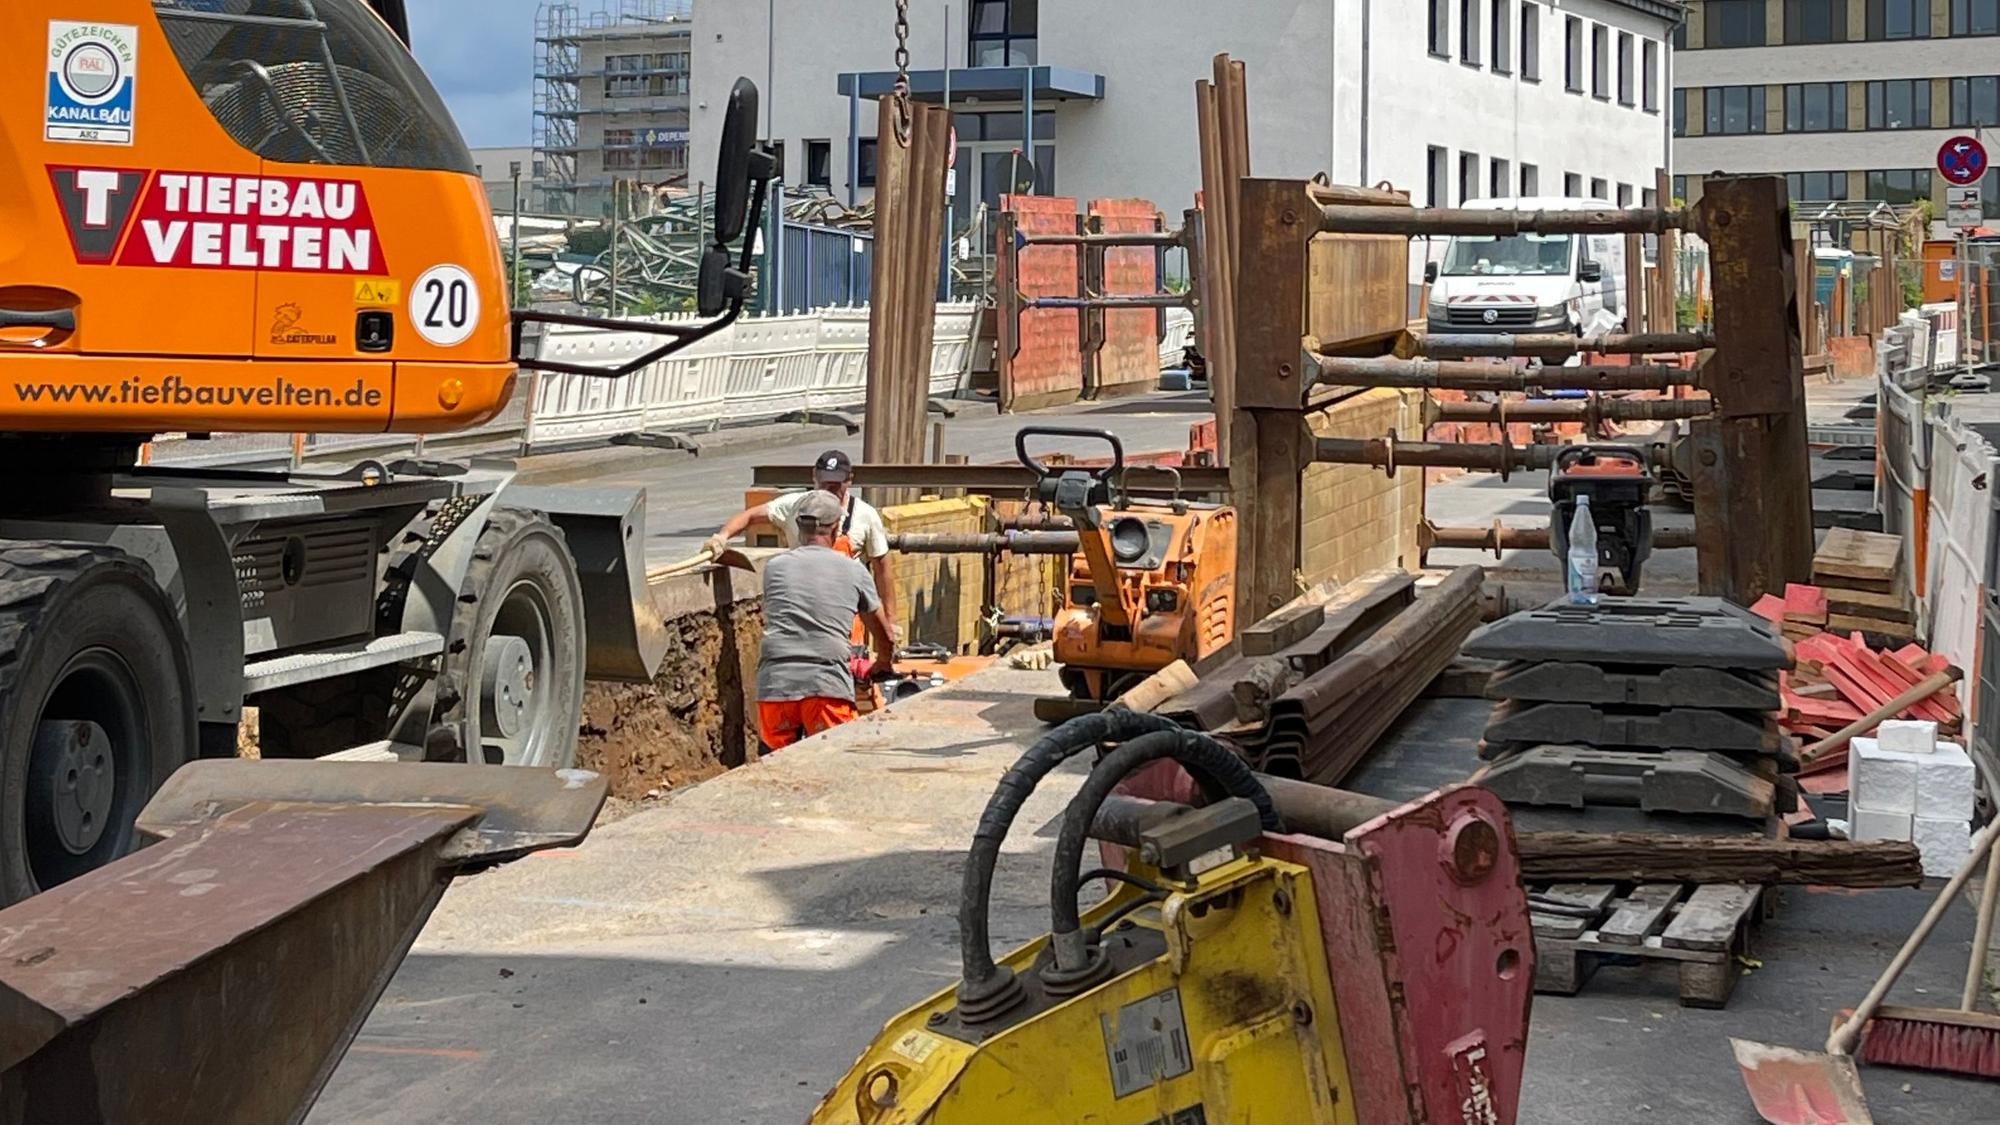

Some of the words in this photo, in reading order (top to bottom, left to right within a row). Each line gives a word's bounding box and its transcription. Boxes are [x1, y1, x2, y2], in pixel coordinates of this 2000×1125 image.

[51, 26, 133, 63] GÜTEZEICHEN
[80, 58, 104, 71] RAL
[48, 105, 131, 123] KANALBAU
[159, 174, 356, 220] TIEFBAU
[141, 219, 371, 271] VELTEN
[424, 278, 468, 328] 20
[14, 375, 383, 408] www.tiefbauvelten.de
